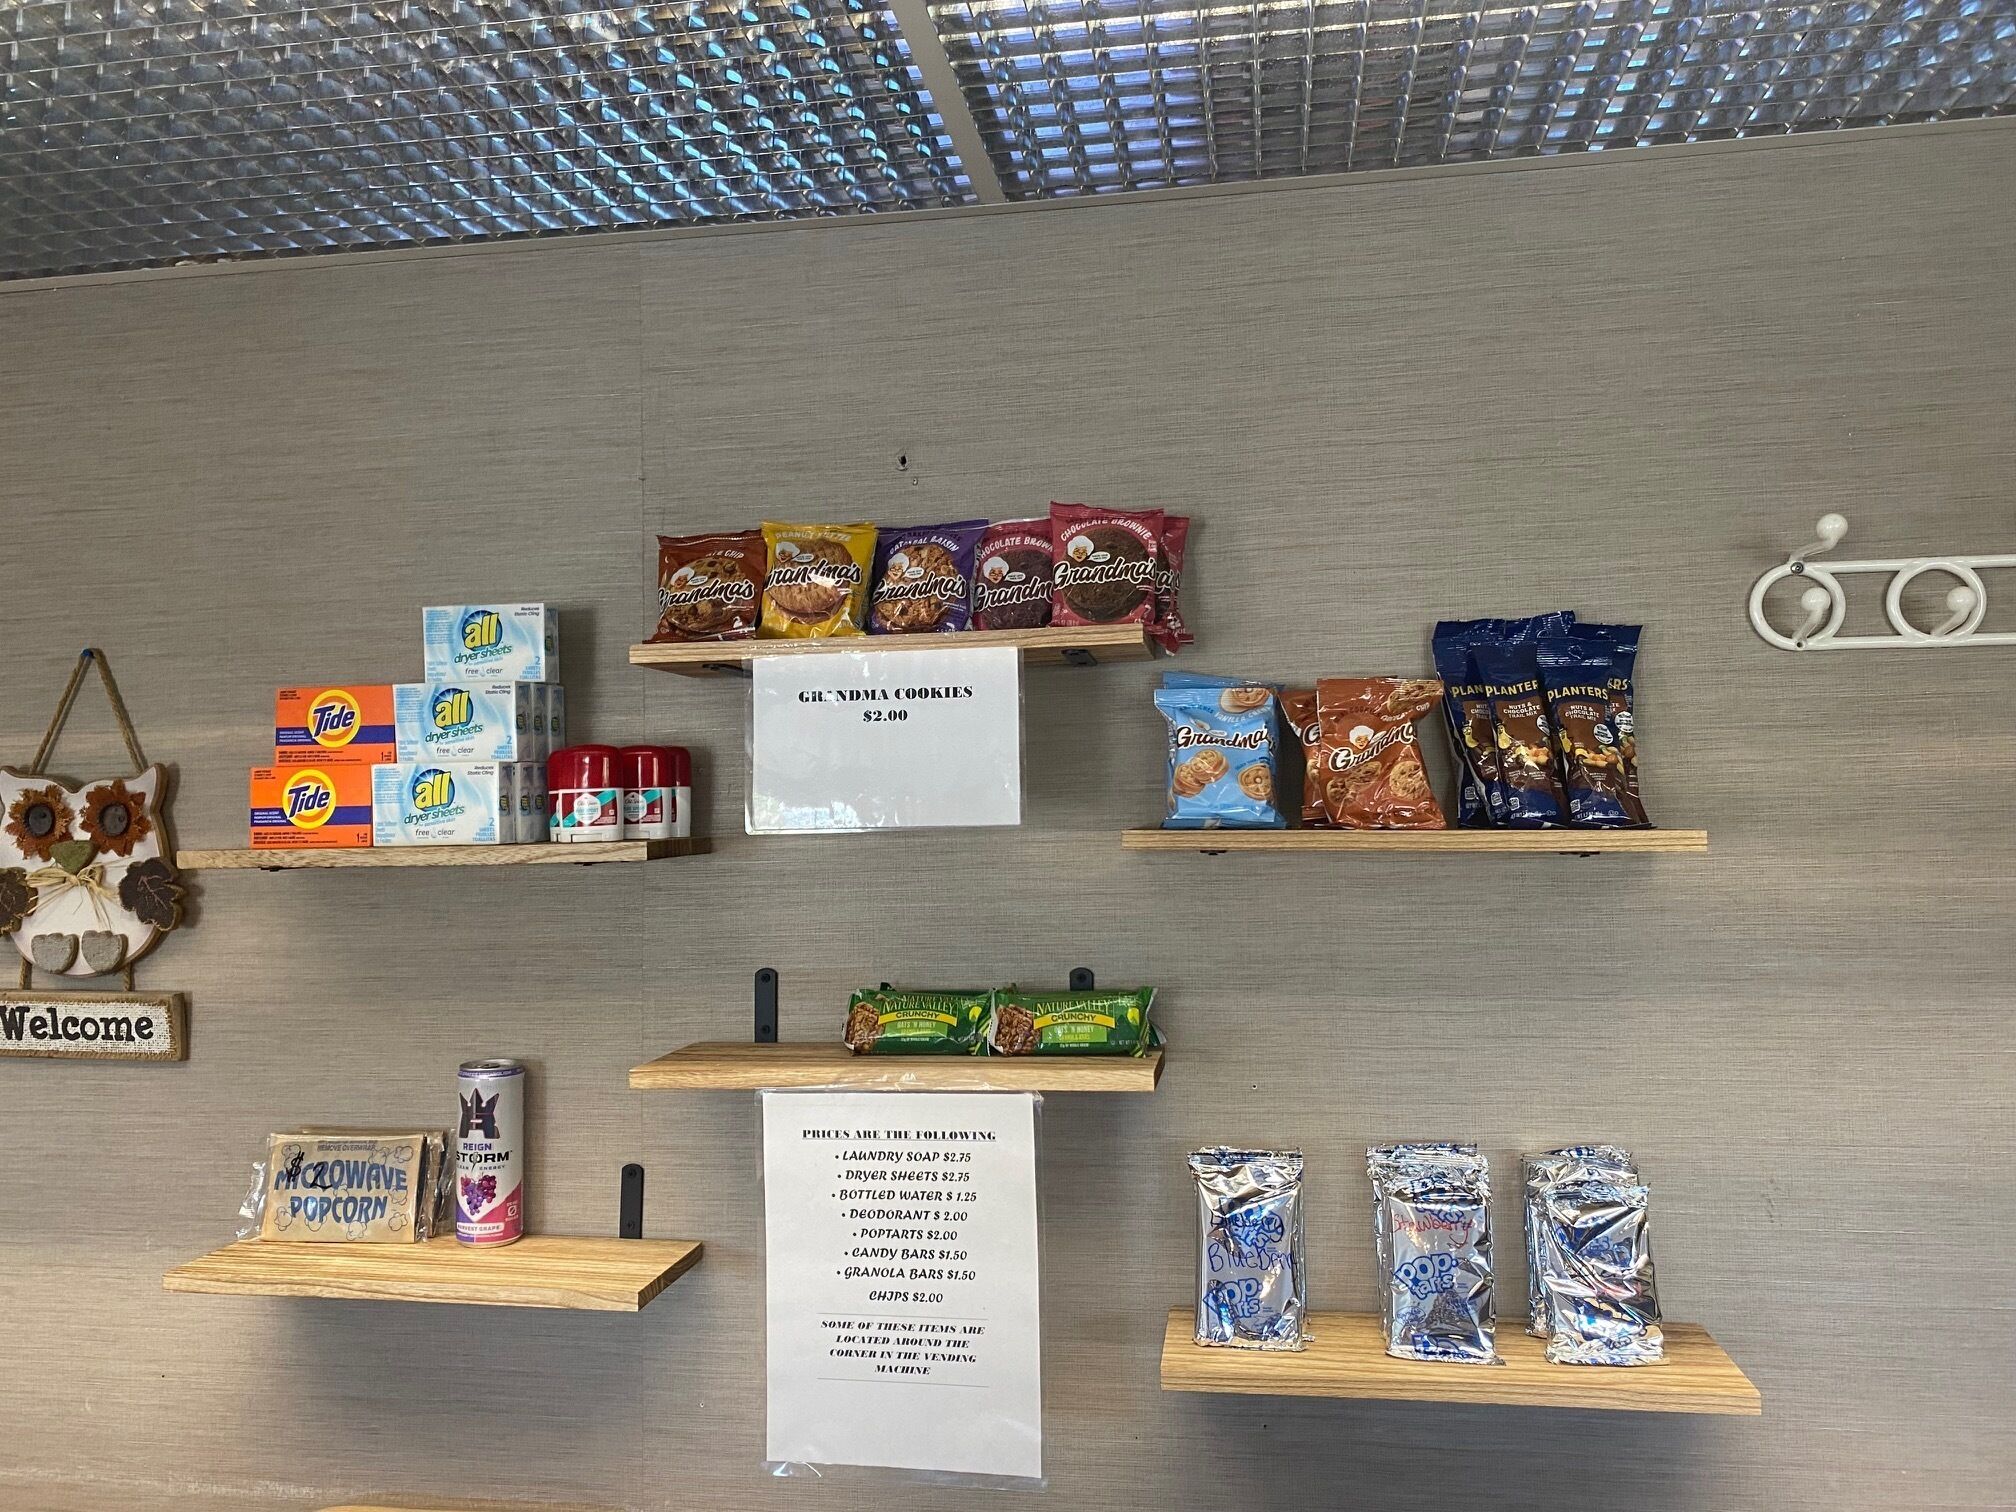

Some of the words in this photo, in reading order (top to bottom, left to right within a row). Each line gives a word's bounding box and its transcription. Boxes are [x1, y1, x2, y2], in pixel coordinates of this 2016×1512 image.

[1060, 519, 1108, 542] CHOCOLATE
[1111, 518, 1152, 539] BROWNIE
[1024, 536, 1053, 552] BROWN
[1053, 557, 1158, 593] Grandma's
[974, 576, 1053, 612] Grandm
[464, 612, 500, 648] all
[454, 652, 481, 665] dryer
[480, 645, 513, 659] sheets
[535, 656, 541, 665] 2
[465, 667, 479, 676] free
[486, 667, 503, 675] clear
[798, 689, 890, 703] GRNDMA
[894, 685, 973, 700] COOKIES
[1452, 684, 1484, 698] PLAN
[1547, 686, 1609, 702] PLANTERS
[434, 691, 470, 727] all
[863, 709, 908, 722] $2.00
[1503, 705, 1541, 714] CHOCOLATE
[1565, 709, 1600, 718] CHOCOLATE
[313, 704, 356, 739] Tide
[425, 731, 452, 744] dryer
[451, 723, 483, 738] sheets
[506, 735, 513, 745] 2
[1176, 726, 1269, 750] Grandma
[436, 747, 450, 755] free
[414, 771, 451, 811] all
[288, 784, 331, 819] Tide
[404, 813, 432, 826] dryer
[432, 805, 465, 819] sheets
[489, 817, 495, 827] 2
[415, 828, 430, 837] free
[437, 828, 455, 836] clear
[883, 1001, 920, 1014] NATURE
[921, 1001, 956, 1014] VALLEY
[1036, 1001, 1073, 1015] NATURE
[1074, 999, 1109, 1014] VALLEY
[895, 1011, 941, 1019] CRUNCHY
[1051, 1013, 1097, 1022] CRUNCHY
[0, 1005, 154, 1042] Welcome
[802, 1129, 851, 1139] PRICES
[853, 1129, 881, 1139] ARE
[884, 1130, 912, 1140] THE
[916, 1130, 996, 1140] FOLLOWING
[463, 1143, 492, 1151] REIGN
[456, 1151, 510, 1164] STORM
[842, 1151, 903, 1163] LAUNDRY
[906, 1151, 940, 1162] SOAP
[943, 1152, 971, 1163] $2.75
[274, 1159, 408, 1192] MICROWAVE
[845, 1170, 887, 1182] DRYER
[890, 1171, 939, 1182] SHEETS
[942, 1171, 970, 1182] $2.75
[839, 1190, 896, 1201] BOTTLED
[899, 1190, 943, 1202] WATER
[290, 1195, 388, 1224] POPCORN
[849, 1209, 931, 1221] DEODORANT
[479, 1225, 500, 1233] GRAPE
[860, 1228, 923, 1240] POPTARTS
[926, 1230, 958, 1241] $2.00
[852, 1248, 898, 1260] CANDY
[901, 1248, 935, 1260] BARS
[938, 1249, 967, 1261] $1.50
[844, 1266, 905, 1280] GRANOLA
[909, 1268, 944, 1280] BARS
[946, 1269, 976, 1281] $1.50
[868, 1290, 909, 1302] CHIPS
[912, 1291, 943, 1303] $2.00
[820, 1319, 854, 1330] SOME
[857, 1321, 874, 1330] OF
[877, 1322, 916, 1332] THESE
[918, 1323, 957, 1334] ITEMS
[959, 1325, 985, 1335] ARE
[835, 1335, 890, 1345] LOCATED
[893, 1337, 942, 1347] AROUND
[945, 1339, 970, 1348] THE
[829, 1348, 877, 1358] CORNER
[880, 1350, 894, 1359] IN
[896, 1351, 921, 1361] THE
[924, 1352, 977, 1363] VENDING
[874, 1364, 931, 1375] MACHINE
